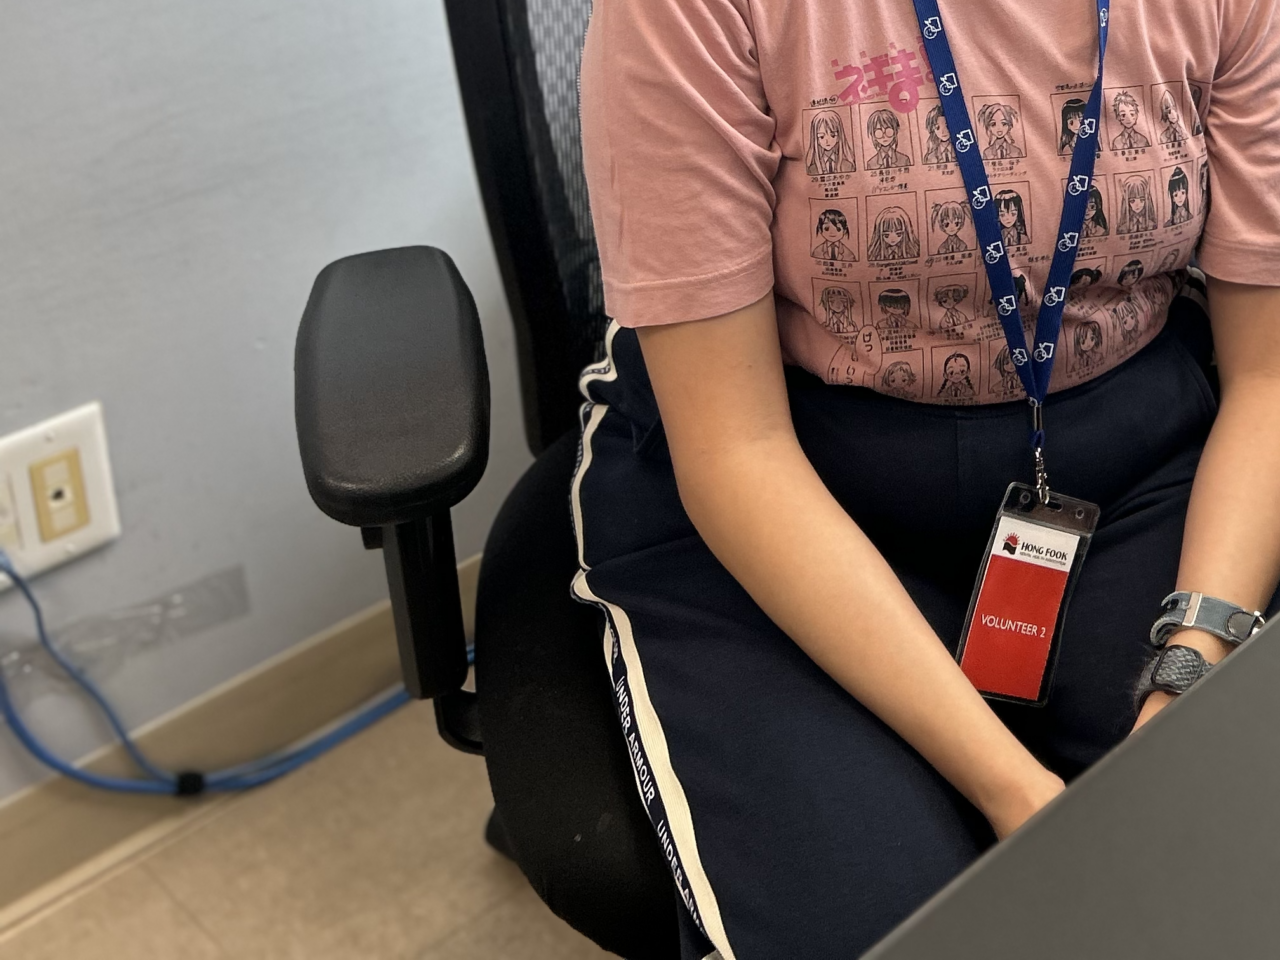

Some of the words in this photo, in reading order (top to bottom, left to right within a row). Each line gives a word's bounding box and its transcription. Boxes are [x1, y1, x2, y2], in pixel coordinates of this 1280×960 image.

[1021, 542, 1044, 555] HONG
[1045, 548, 1068, 561] FOOK
[980, 614, 1038, 637] VOLUNTEER
[1040, 627, 1046, 638] 2
[616, 676, 632, 734] UNDER
[629, 733, 656, 805] ARMOUR
[657, 820, 683, 884] UNDER
